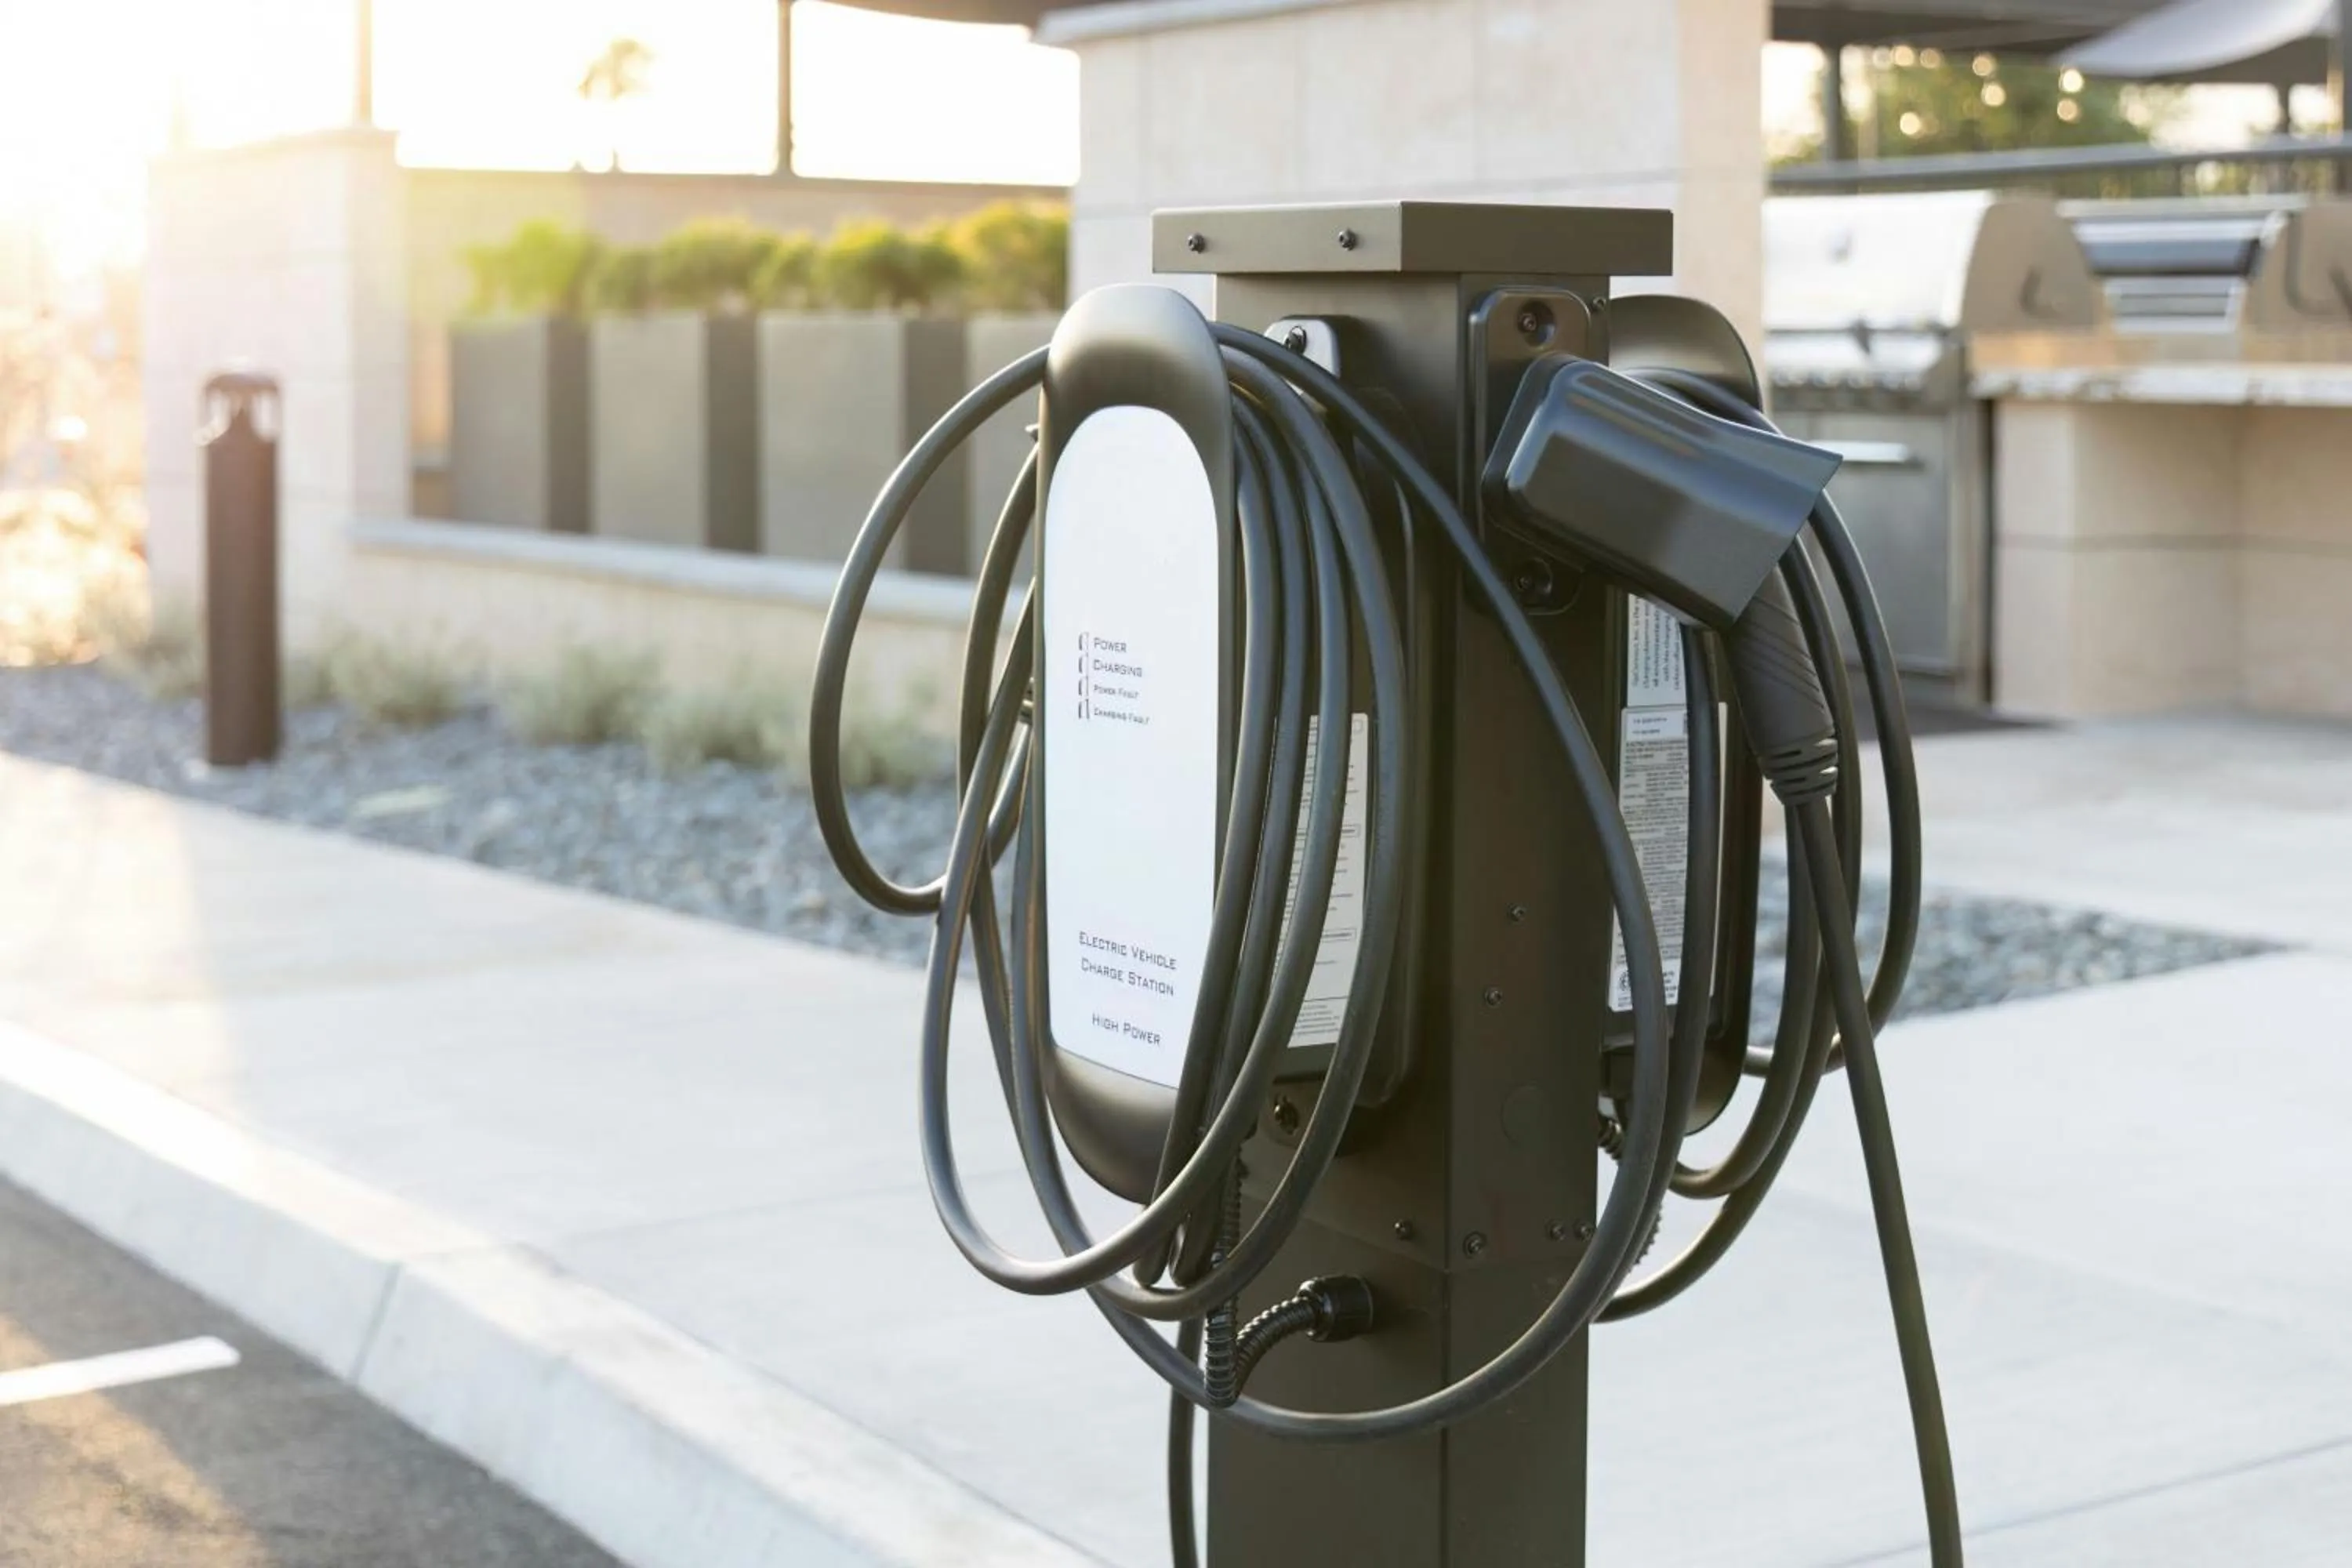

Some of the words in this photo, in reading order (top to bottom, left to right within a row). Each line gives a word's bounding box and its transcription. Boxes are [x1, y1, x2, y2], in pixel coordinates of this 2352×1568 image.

[1094, 637, 1127, 652] POWER
[1093, 659, 1142, 677] CHARGING
[1079, 931, 1127, 956] ELECTRIC
[1131, 946, 1177, 970] VEHICLE
[1081, 957, 1124, 982] CHARGE
[1128, 971, 1174, 996] STATION
[1092, 1013, 1118, 1032] HIGH
[1123, 1022, 1160, 1045] POWER
